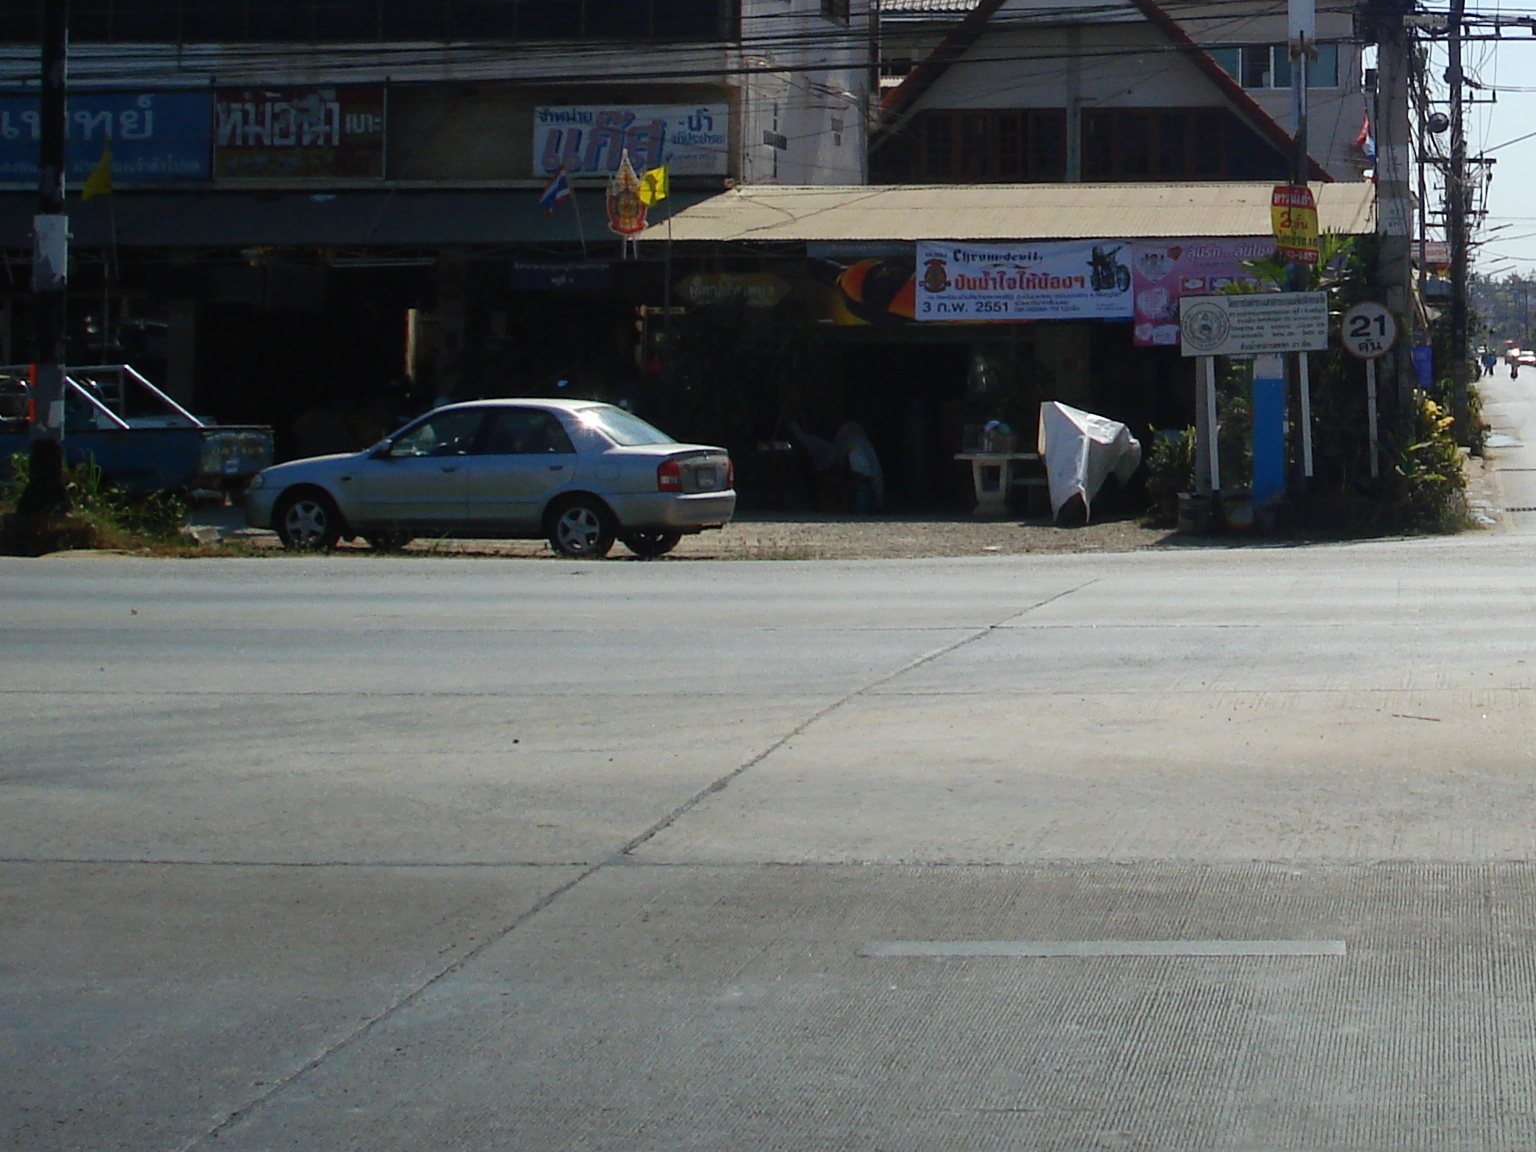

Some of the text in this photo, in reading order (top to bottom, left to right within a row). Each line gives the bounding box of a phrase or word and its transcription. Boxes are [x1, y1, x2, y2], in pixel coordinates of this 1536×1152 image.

[922, 302, 932, 313] 3
[937, 303, 968, 313] ก.พ.
[975, 302, 1009, 313] 2551
[1350, 314, 1386, 338] 21
[1358, 338, 1383, 353] ตัน
